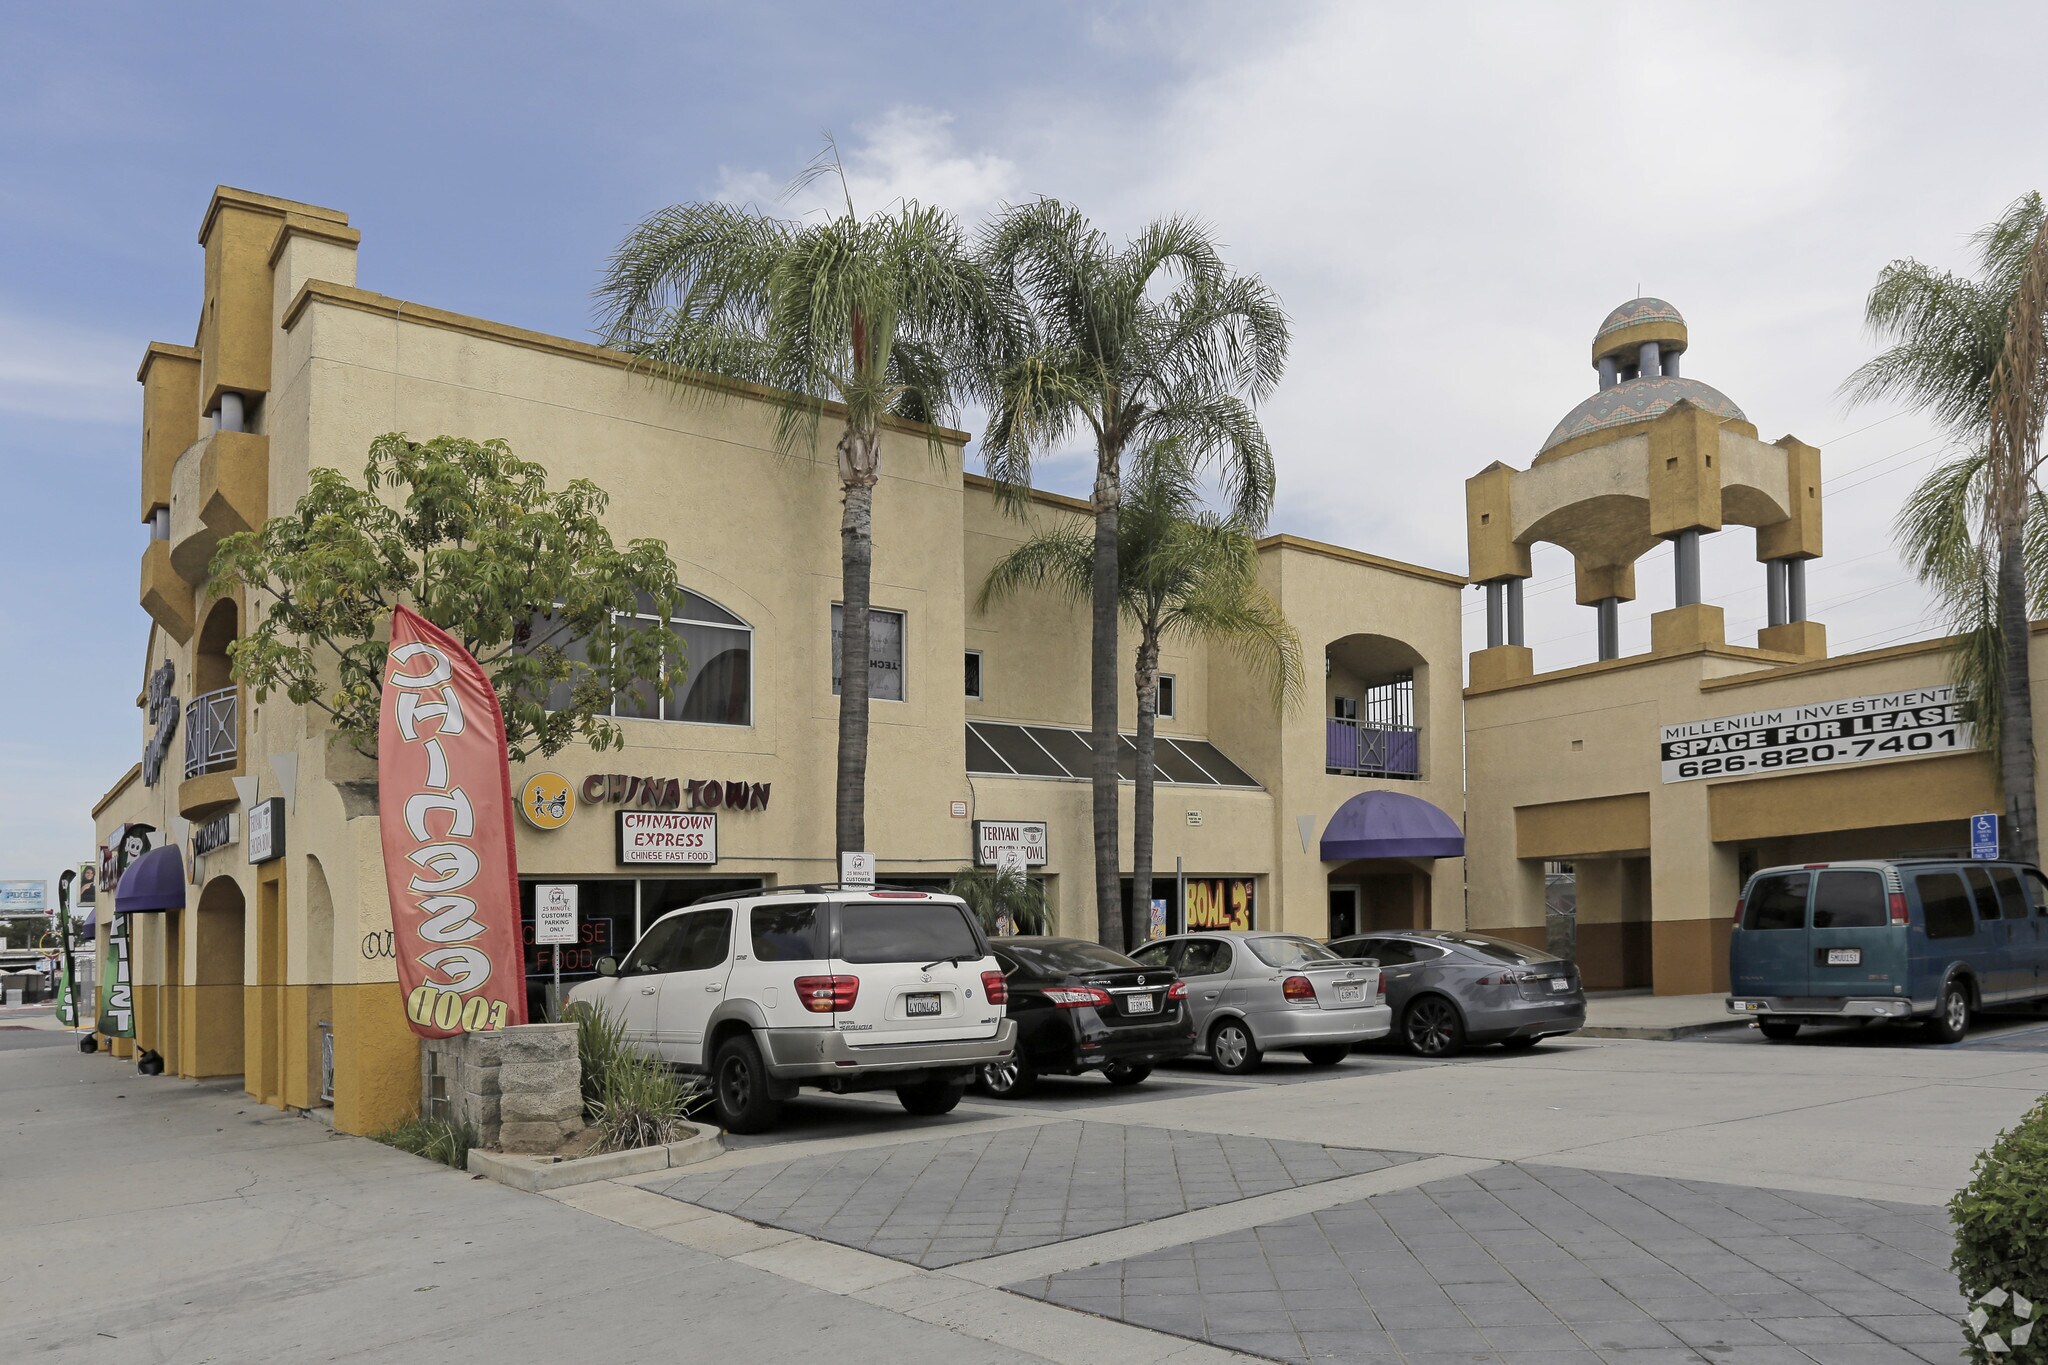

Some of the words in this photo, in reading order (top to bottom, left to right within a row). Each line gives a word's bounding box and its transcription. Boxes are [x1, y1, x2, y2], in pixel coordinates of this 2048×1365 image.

[1666, 712, 1782, 740] MILLENIUM
[1796, 688, 1970, 721] INVESTMENTS
[1670, 731, 1767, 758] SPACE
[1778, 721, 1841, 745] FOR
[1853, 704, 1966, 735] LEASE
[1679, 729, 1956, 778] 626-820-7401
[625, 815, 713, 830] CHINATOWN
[634, 833, 704, 847] EXPRESS
[982, 826, 1019, 841] TERIYAKI
[631, 851, 663, 860] CHINESE
[666, 852, 684, 860] FAST
[688, 852, 708, 861] FOOD
[1021, 846, 1044, 860] OWL
[537, 948, 593, 971] FOOD
